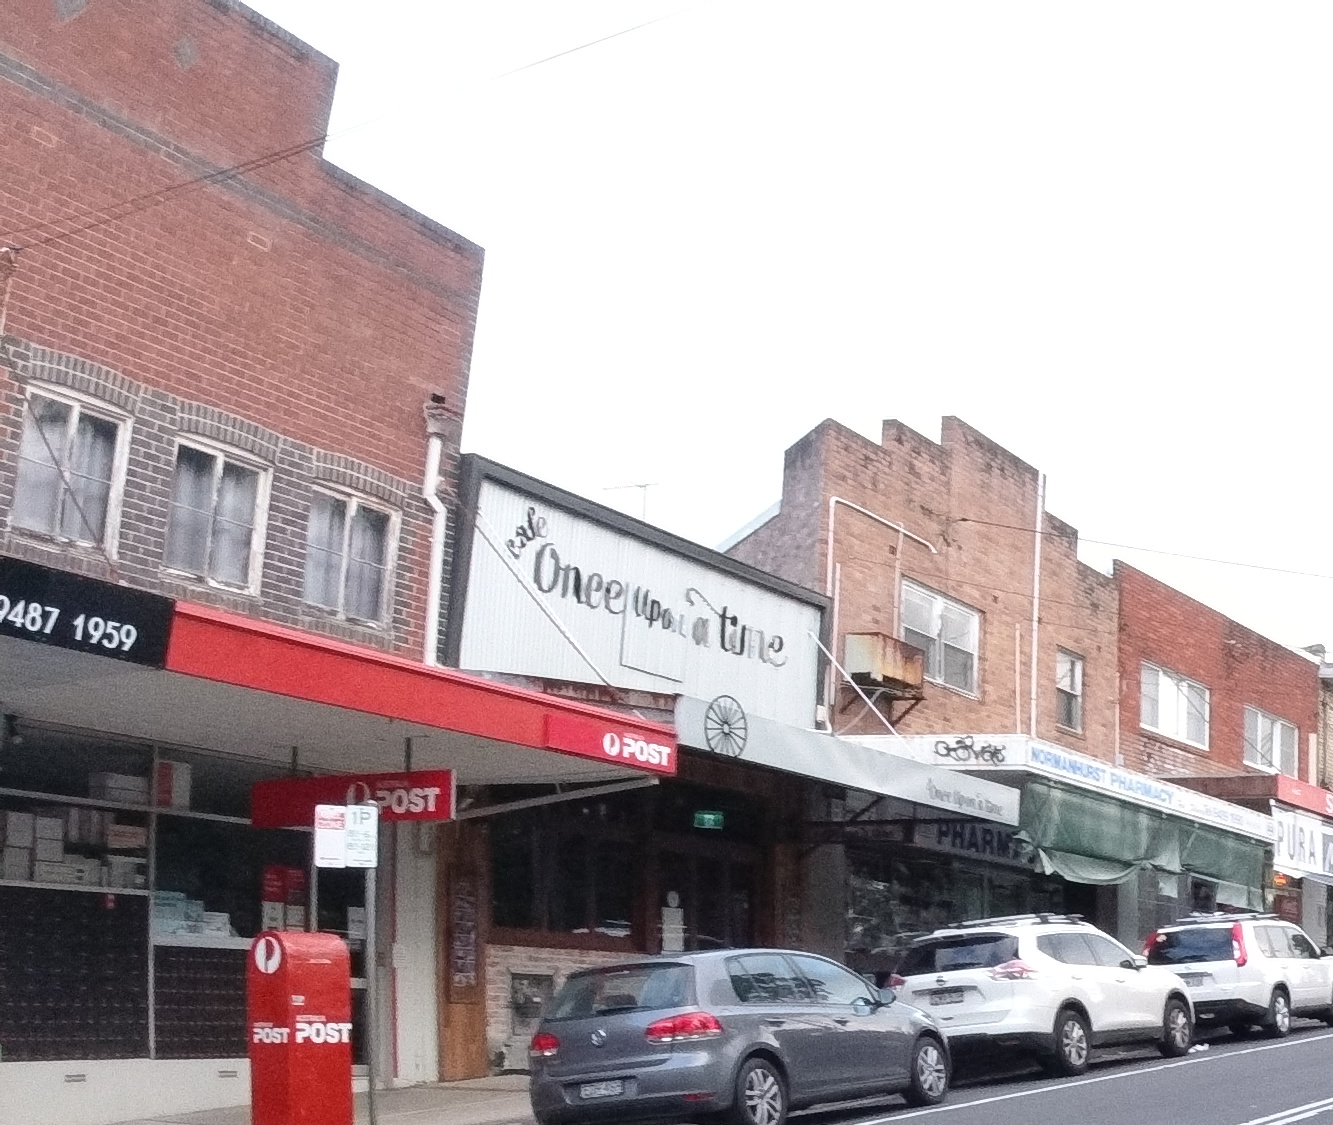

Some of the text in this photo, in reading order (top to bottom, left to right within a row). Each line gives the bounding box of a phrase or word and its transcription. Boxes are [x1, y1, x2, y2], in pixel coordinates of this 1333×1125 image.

[72, 613, 138, 651] 1959
[622, 736, 671, 766] POST
[375, 786, 441, 814] POST
[1110, 771, 1174, 804] PHARMACY
[253, 1022, 353, 1044] POST POST
